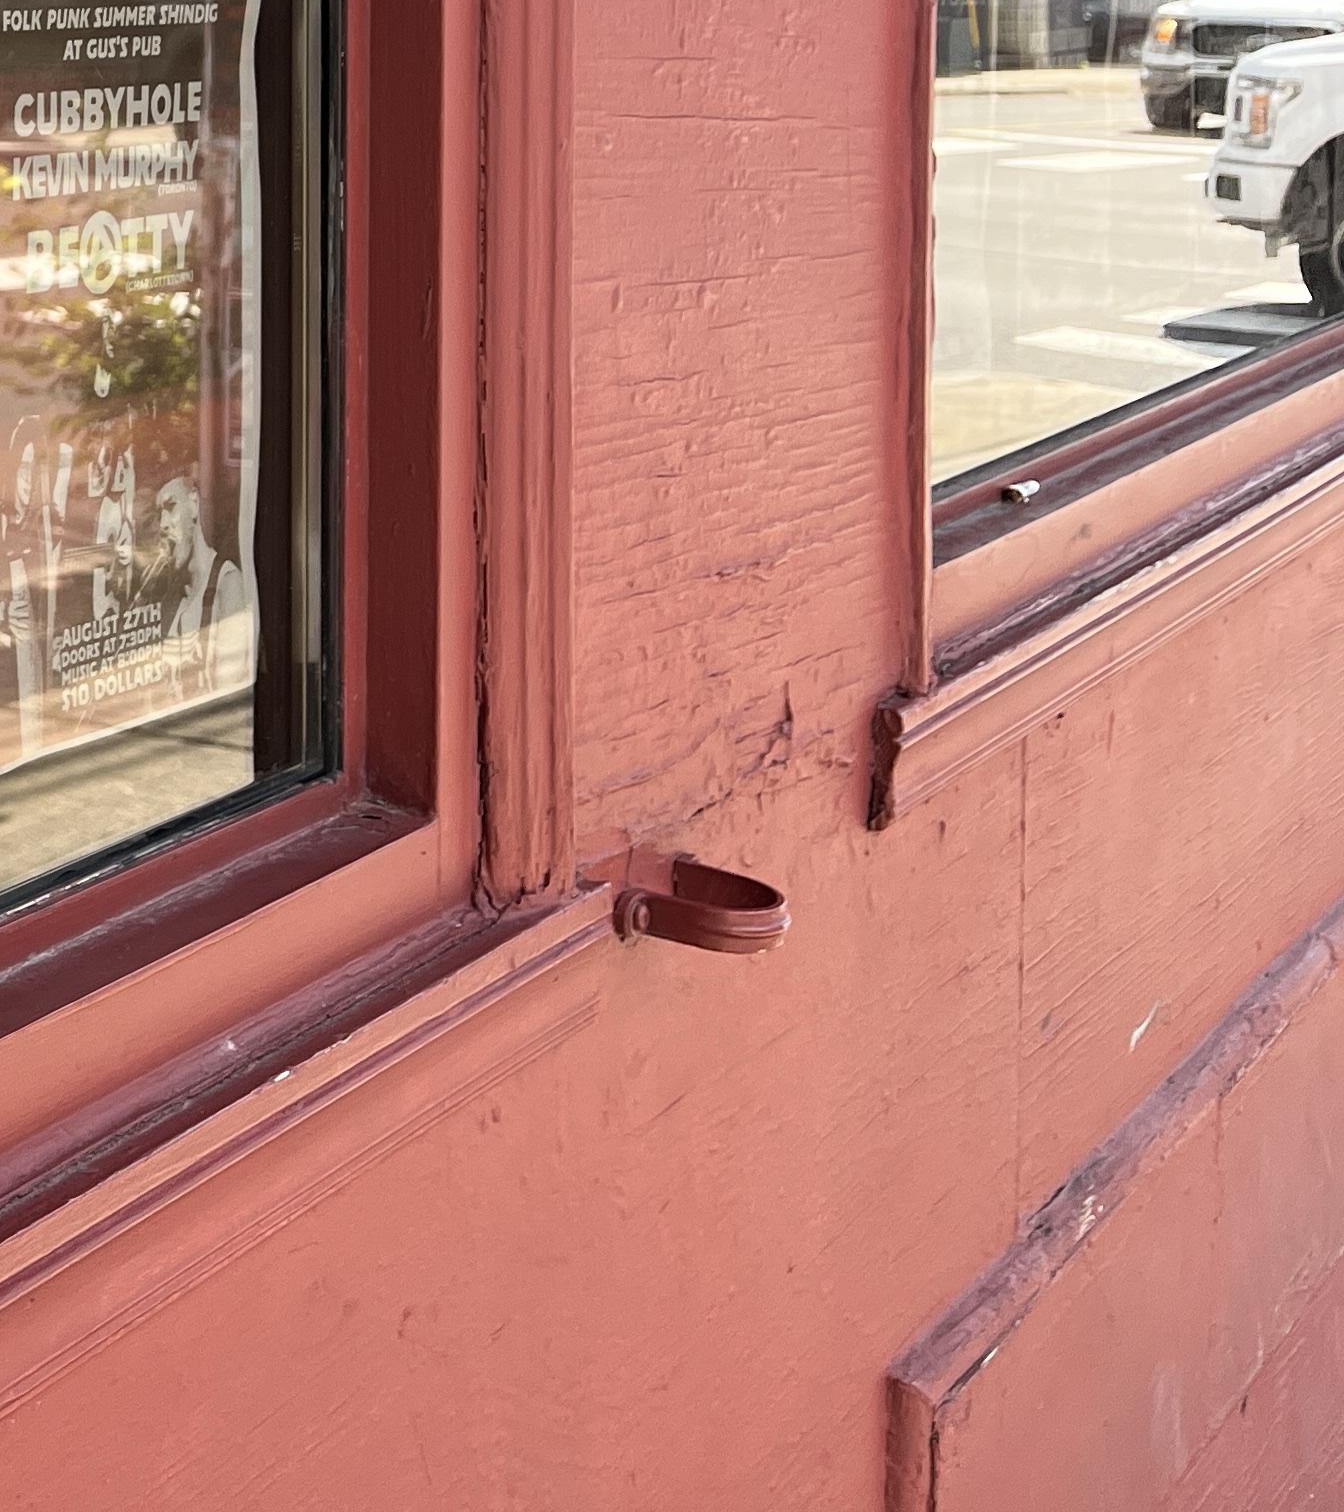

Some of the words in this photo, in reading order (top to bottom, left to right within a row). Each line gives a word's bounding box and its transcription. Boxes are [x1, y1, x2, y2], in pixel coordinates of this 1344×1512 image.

[2, 8, 41, 31] FOLK
[46, 6, 90, 29] PUNK
[94, 5, 155, 27] SUMMER
[159, 3, 218, 25] SHINDIG
[63, 39, 83, 60] AT
[86, 35, 128, 59] GUS'S
[132, 35, 161, 57] PUB
[13, 80, 204, 138] CUBBYHOLE
[12, 150, 89, 201] KEVIN
[94, 139, 199, 192] MURPHY
[61, 616, 119, 648] AUGUST
[123, 603, 161, 630] 27TH
[94, 660, 164, 701] DOLLARS
